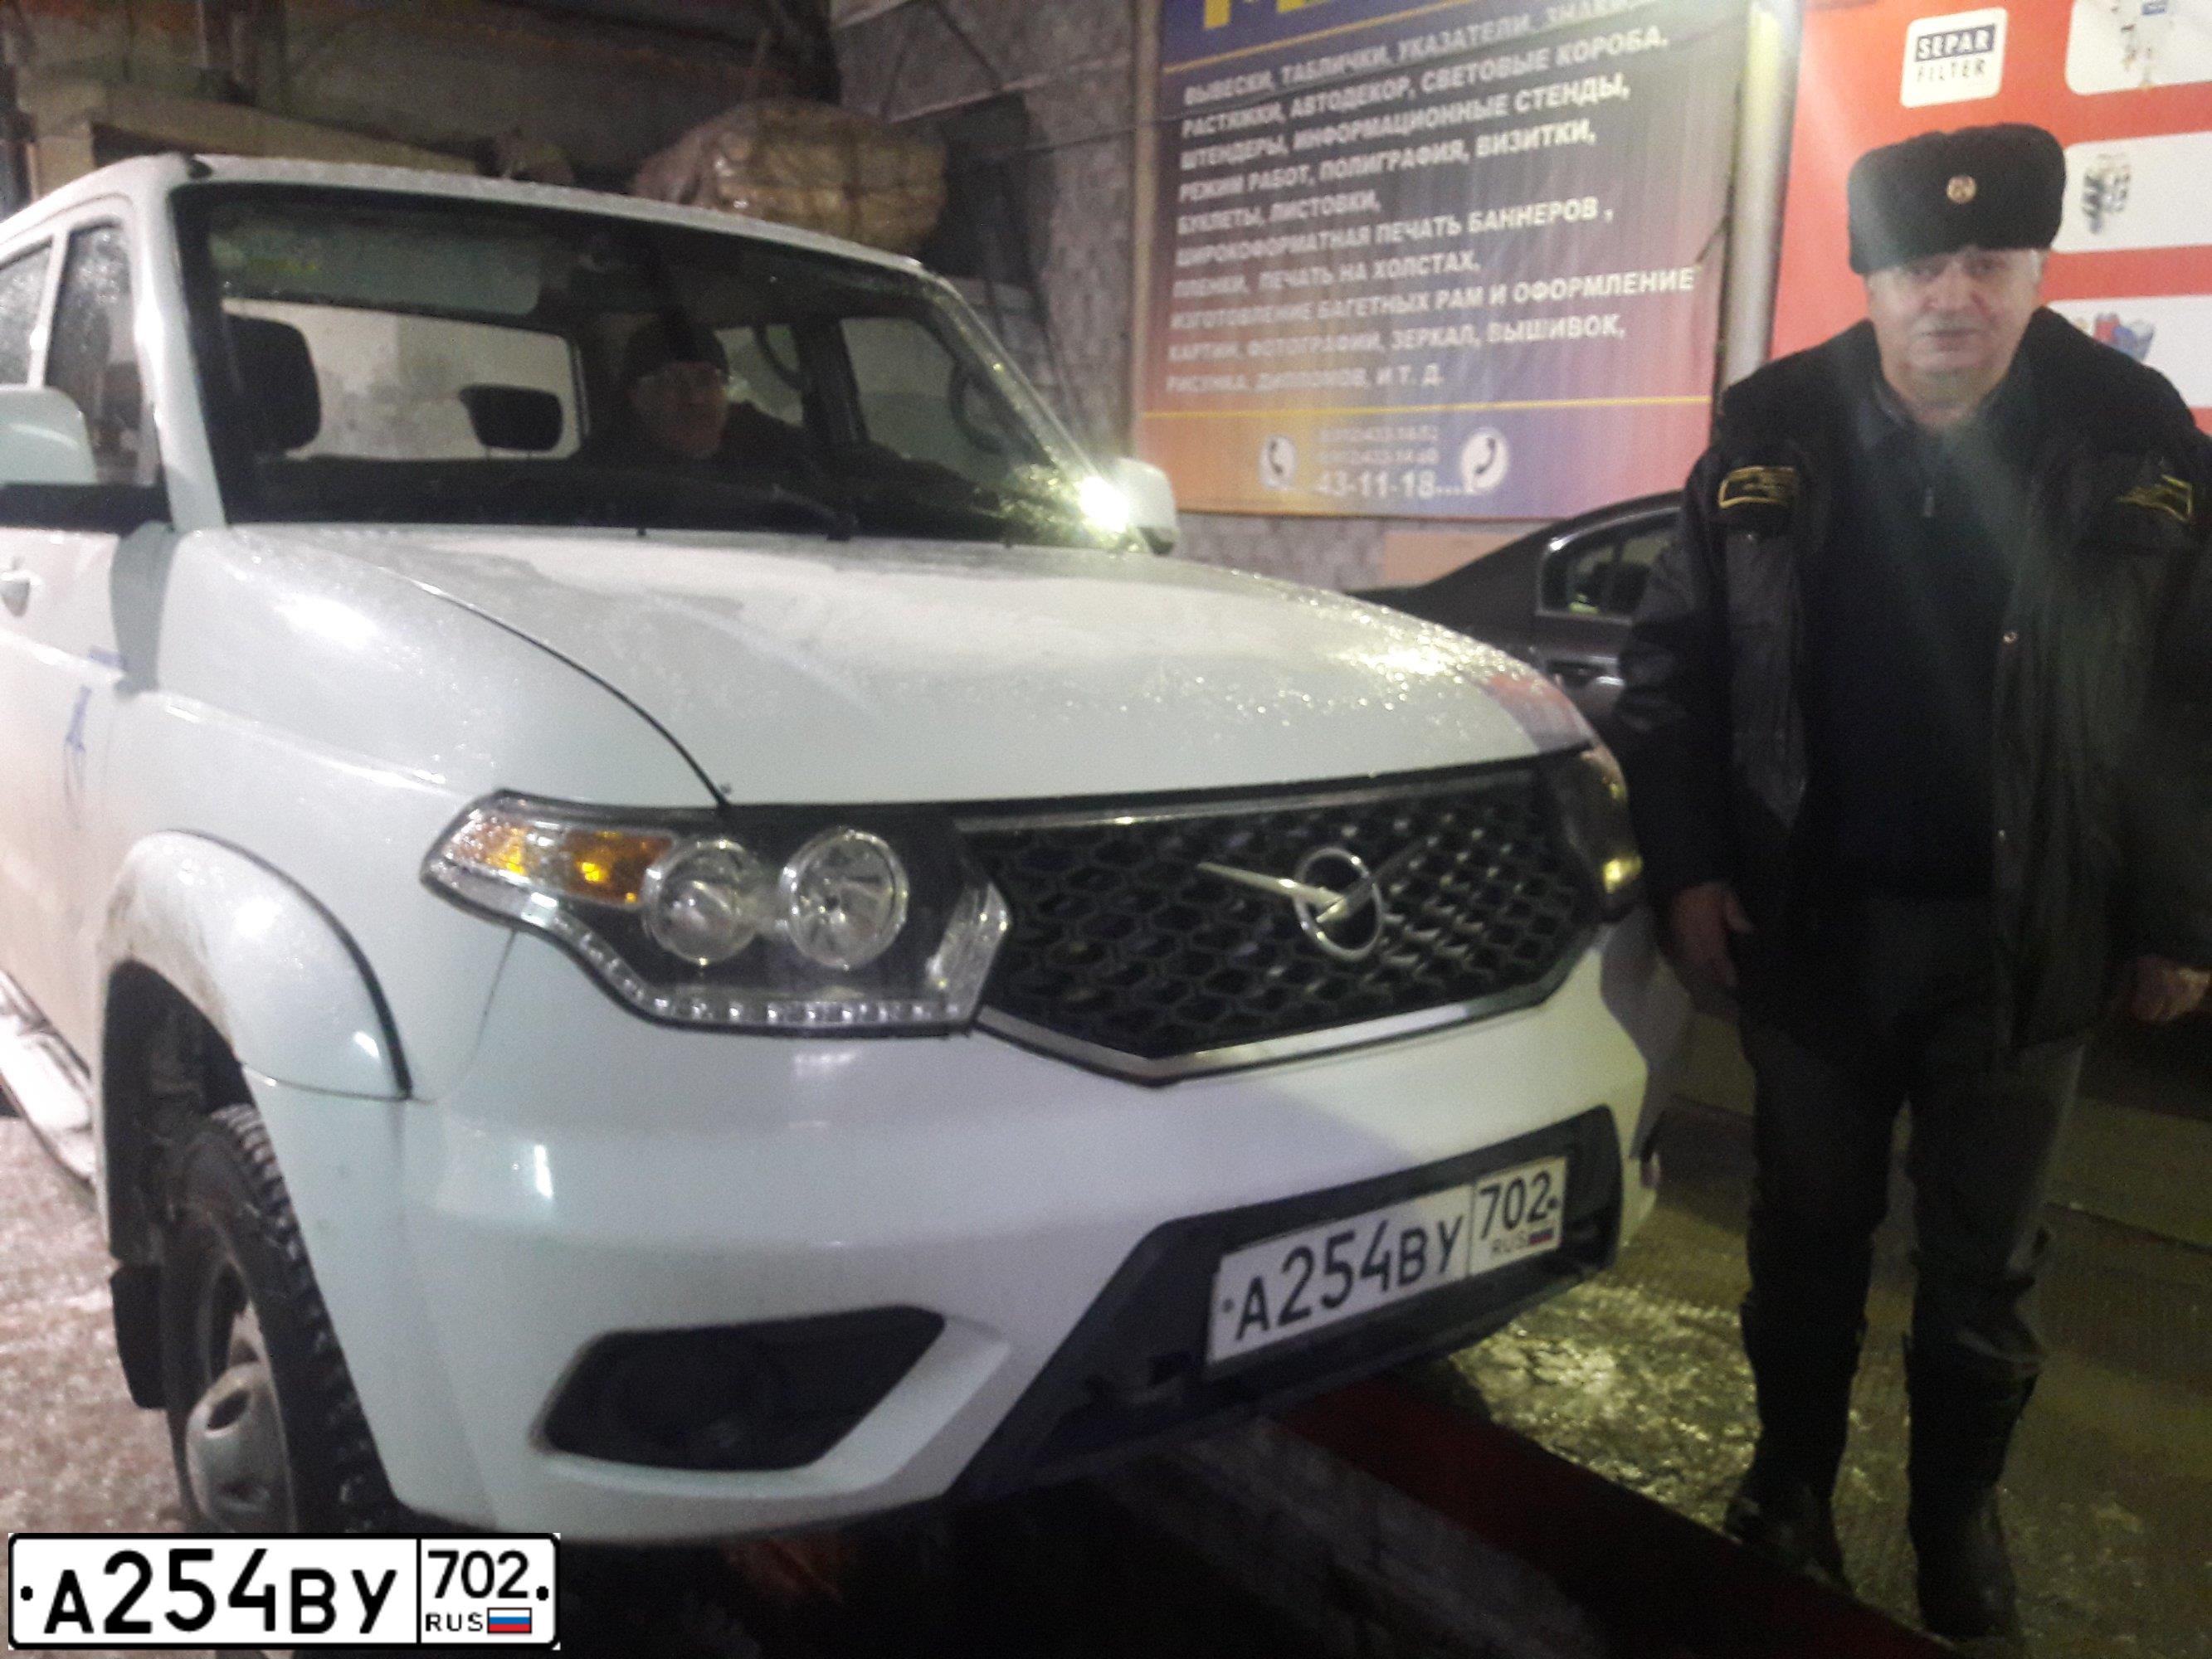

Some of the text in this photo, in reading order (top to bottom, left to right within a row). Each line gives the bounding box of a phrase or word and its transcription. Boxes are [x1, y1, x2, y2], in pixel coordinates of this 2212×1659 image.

[1917, 27, 1993, 59] SEPAR
[1420, 47, 1551, 93] СВЕТОВЫЕ
[1916, 58, 1986, 82] FILTER
[1294, 93, 1508, 150] ИНФОРМАЦИОННЫЕ
[1513, 72, 1631, 114] СТЕНДЫ,
[1319, 139, 1469, 182] ПОЛИГРАФИЯ,
[1475, 118, 1597, 158] ВИЗИТКИ,
[1374, 214, 1463, 245] ПЕЧАТЬ
[1258, 265, 1333, 290] ПЕЧАТЬ
[1337, 260, 1368, 283] НА
[1170, 265, 1696, 330] ИЗГОТОВЛЕНИЕ БАГЕТНЫХ РАМ И ОФОРМЛЕНИЕ
[1487, 312, 1626, 345] ВЫШИВОК,
[1479, 1170, 1552, 1240] 702
